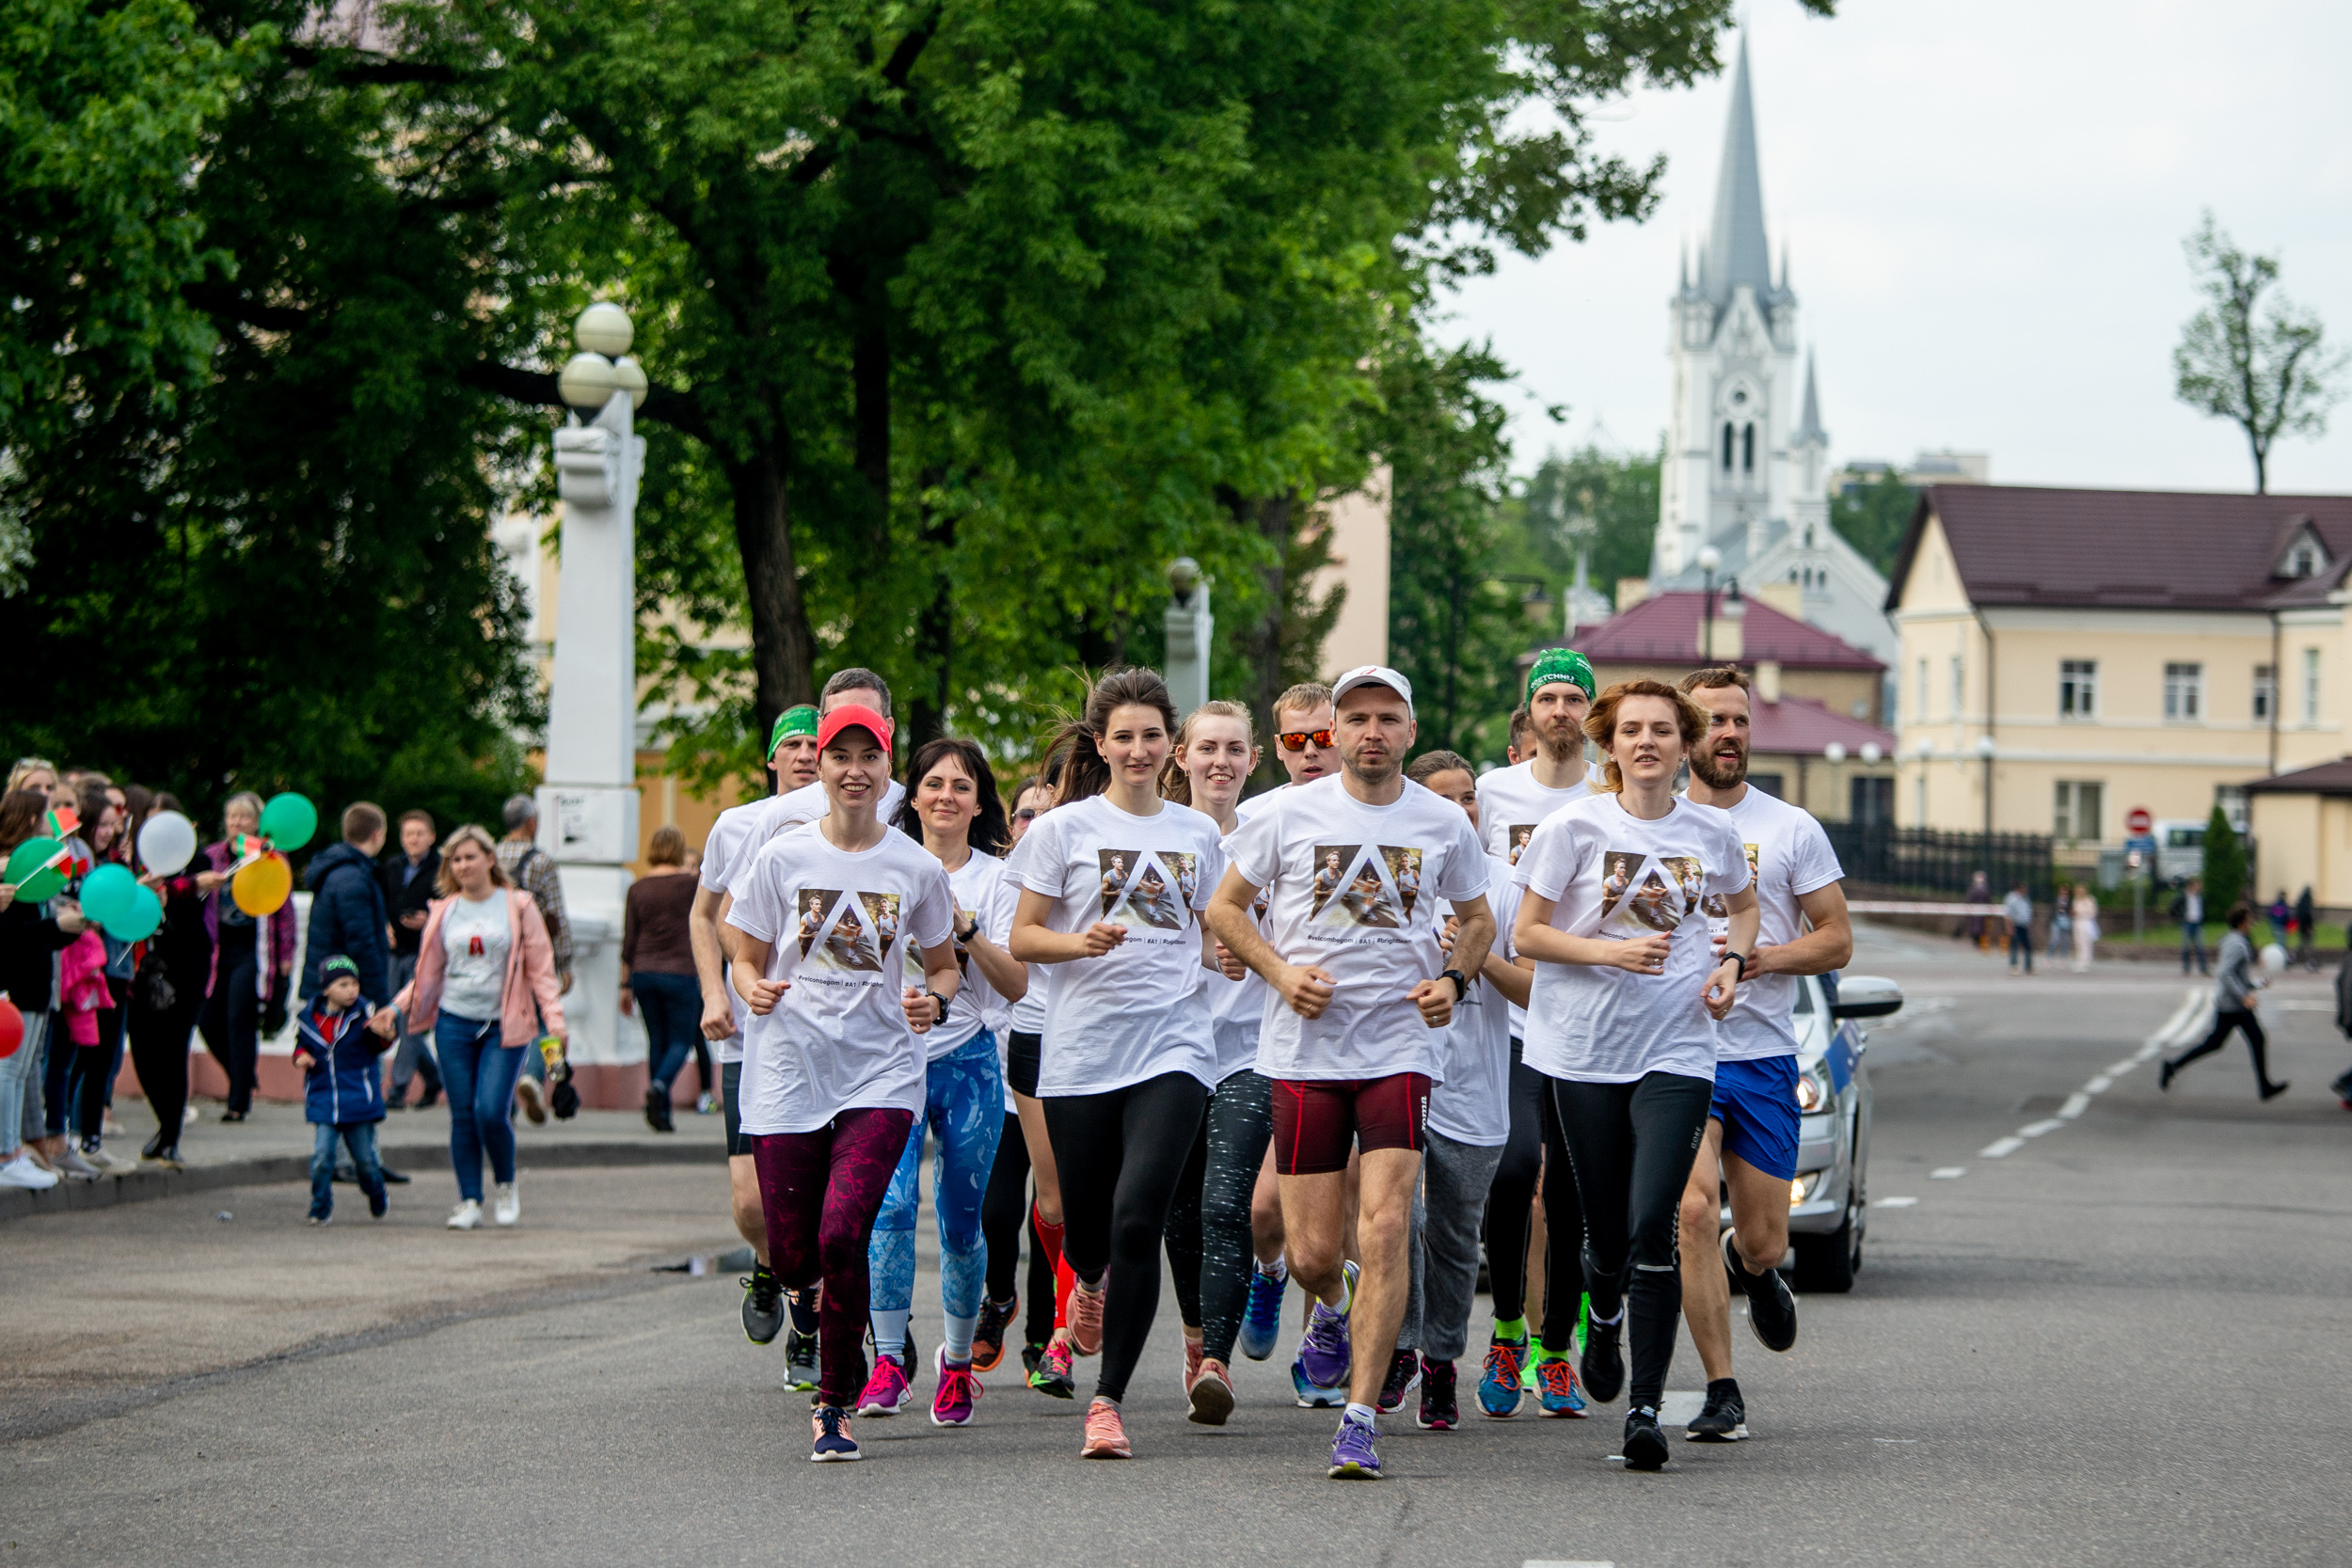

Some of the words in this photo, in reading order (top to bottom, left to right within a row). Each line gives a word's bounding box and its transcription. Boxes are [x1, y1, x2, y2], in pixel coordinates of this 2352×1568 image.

[1307, 934, 1354, 944] #velcombegom
[1376, 937, 1412, 945] #brightteam
[798, 974, 840, 987] #velcombegom
